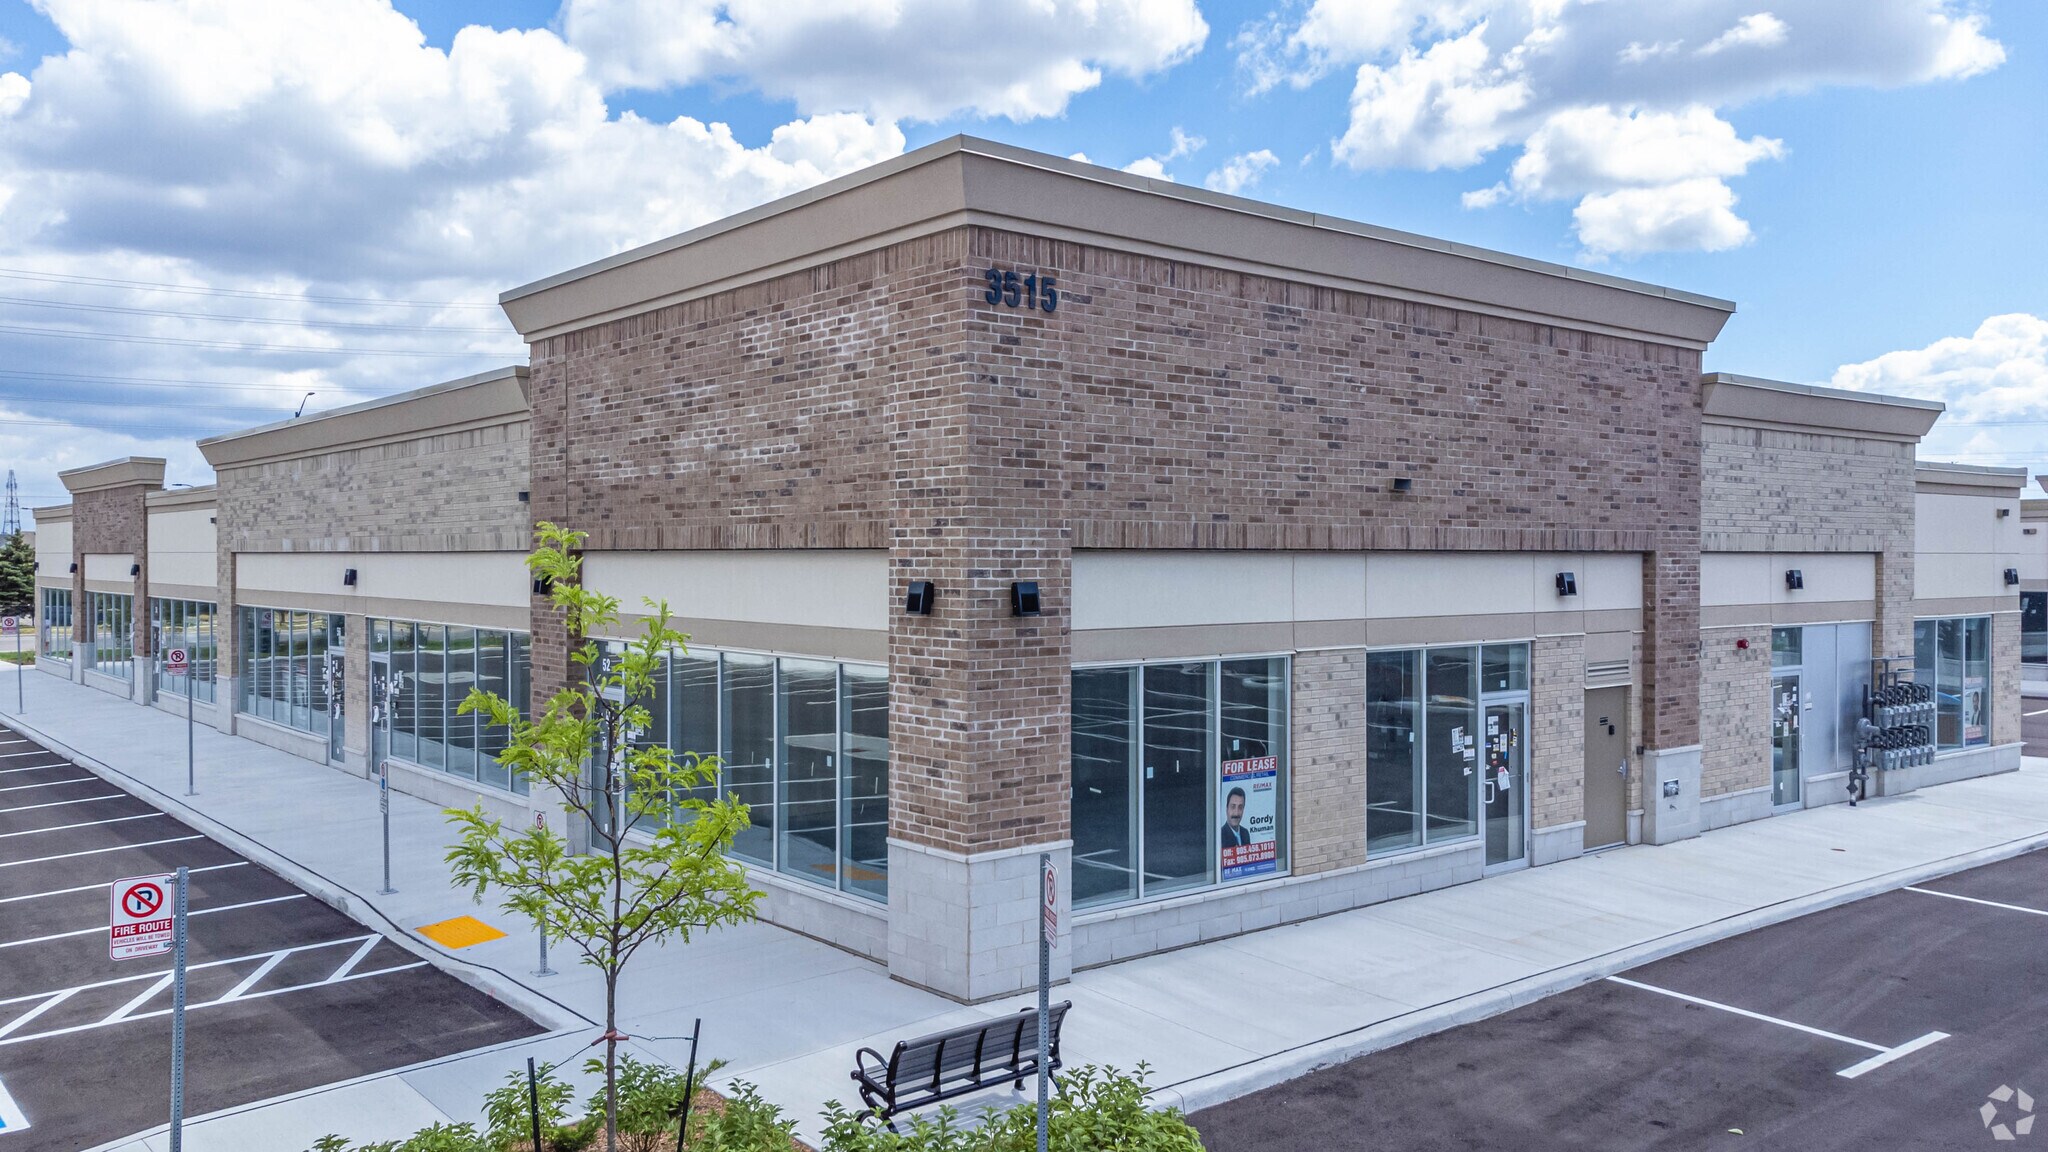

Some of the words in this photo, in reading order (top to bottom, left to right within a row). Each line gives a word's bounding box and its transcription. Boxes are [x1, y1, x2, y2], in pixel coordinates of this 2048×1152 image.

[985, 268, 1057, 312] 3515
[602, 658, 611, 672] 52
[1225, 761, 1244, 774] FOR
[1246, 758, 1275, 772] LEASE
[1250, 814, 1273, 825] Gordy
[1250, 825, 1274, 833] Khuman
[1223, 858, 1235, 866] Fax:
[114, 924, 136, 937] FIRE
[138, 920, 171, 933] ROUTE
[113, 937, 134, 945] VEHICLES
[154, 931, 170, 939] TOWED
